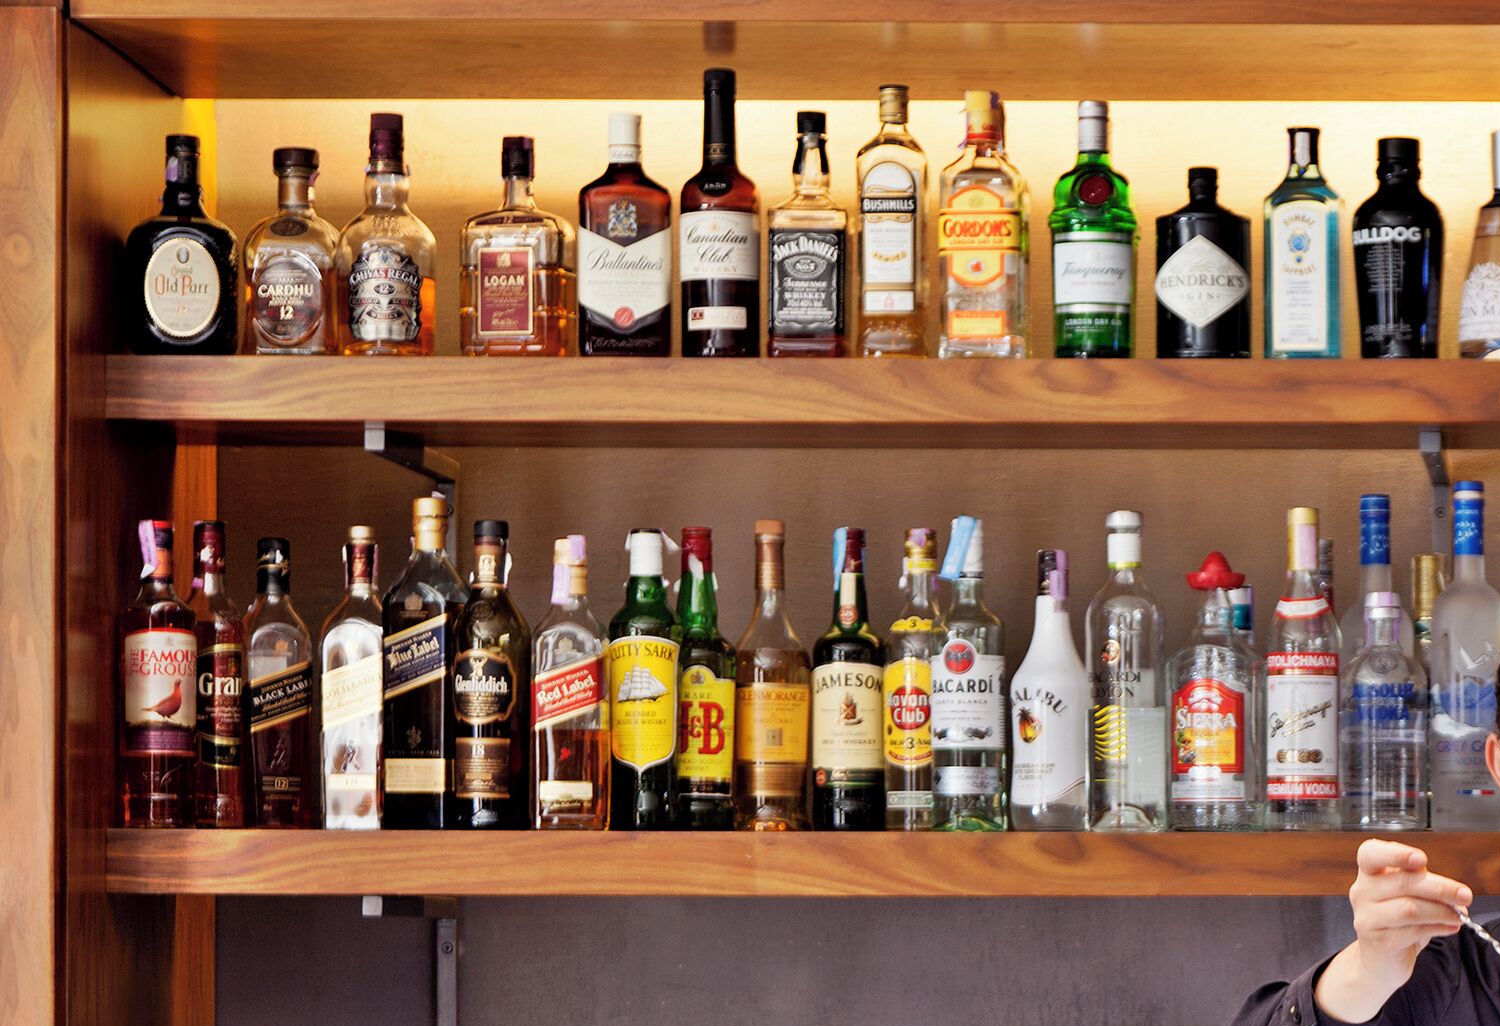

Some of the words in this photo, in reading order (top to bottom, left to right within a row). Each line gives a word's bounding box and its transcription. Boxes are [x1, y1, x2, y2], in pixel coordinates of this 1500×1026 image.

[863, 198, 915, 212] BUSHMILLS
[943, 219, 1012, 239] GORDON'S
[1283, 214, 1316, 227] BOMBAY
[685, 226, 749, 246] Canadian
[1353, 226, 1422, 246] BULLDOG
[697, 245, 730, 264] Club
[774, 240, 799, 260] JACK
[799, 236, 839, 263] DANIEL'S
[586, 248, 663, 272] Ballantine's
[350, 269, 387, 285] CHIVAS
[388, 268, 420, 286] REGAL
[1062, 261, 1127, 280] Tanqueray
[155, 273, 178, 296] Old
[181, 274, 209, 295] Parr
[257, 283, 314, 298] CARDHU
[484, 275, 525, 287] LOGAN
[1160, 274, 1244, 289] HENDRICK'S
[279, 307, 294, 320] 12
[909, 618, 917, 628] 3
[388, 646, 413, 669] Blue
[410, 635, 440, 659] Label
[644, 644, 676, 663] SARK
[1267, 654, 1336, 668] STOLICHNAYA
[454, 675, 509, 695] Glenfiddich
[537, 687, 562, 706] Red
[562, 675, 597, 697] Label
[814, 671, 883, 695] JAMESON
[253, 687, 286, 706] BLACK
[893, 709, 926, 724] Club
[1176, 704, 1238, 729] SIERRA
[471, 743, 486, 757] 18
[904, 737, 915, 749] 3
[277, 779, 287, 788] 12
[1305, 781, 1337, 796] VODKA
